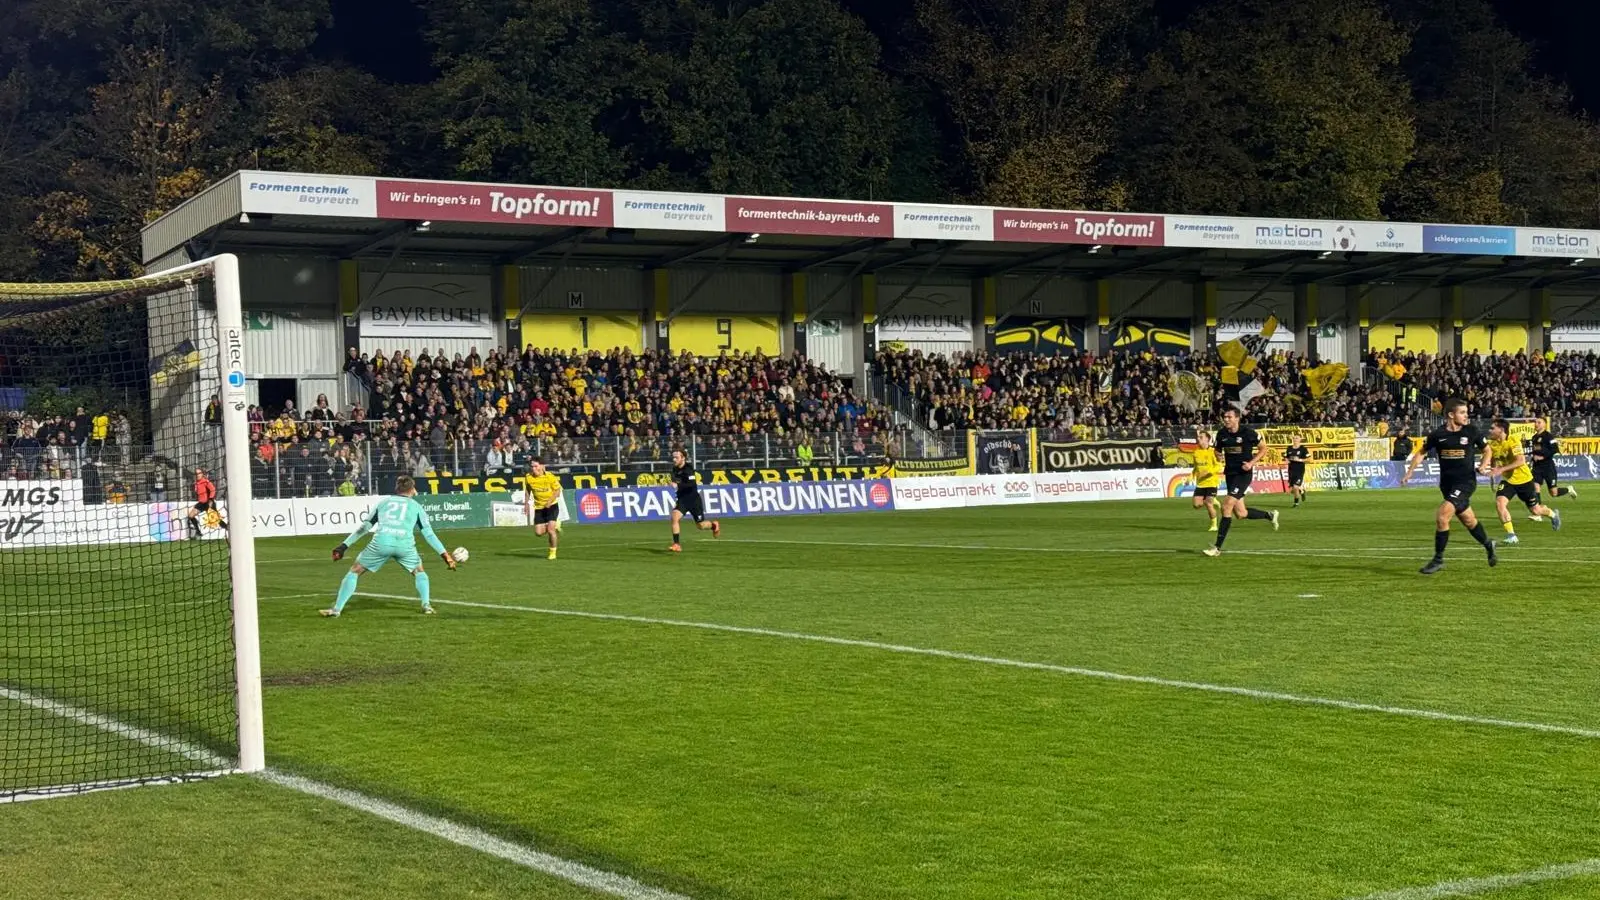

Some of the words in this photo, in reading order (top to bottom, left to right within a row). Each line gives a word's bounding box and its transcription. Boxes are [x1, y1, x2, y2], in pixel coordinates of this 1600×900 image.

[249, 182, 350, 195] Formentechnik
[299, 194, 359, 206] Bayreuth
[390, 191, 410, 204] Wir
[469, 194, 482, 206] in
[489, 191, 600, 220] Topform!
[624, 200, 706, 213] Formentechnik
[663, 211, 714, 222] Bayreuth
[737, 206, 881, 226] formentechnik-bayreuth.de
[903, 212, 974, 224] Formentechnik
[937, 221, 981, 232] Bayreuth
[1002, 217, 1019, 229] Wir
[1060, 220, 1069, 231] in
[1073, 217, 1155, 241] Topform!
[1173, 222, 1235, 234] Formentechnik
[1255, 224, 1324, 239] motion
[1202, 231, 1241, 241] Bayreuth
[1271, 238, 1284, 247] MAN
[1531, 231, 1589, 247] motion
[570, 292, 583, 308] M
[1031, 300, 1043, 315] N
[371, 306, 481, 327] BAYREUTH
[229, 329, 241, 369] artec
[1349, 465, 1390, 477] LEBEN.
[895, 483, 996, 501] hagebaumarkt
[1035, 478, 1128, 497] hagebaumarkt
[2, 487, 60, 507] MGS
[605, 487, 741, 518] FRANEN
[744, 483, 868, 512] BRUNNEN
[385, 502, 408, 521] 21
